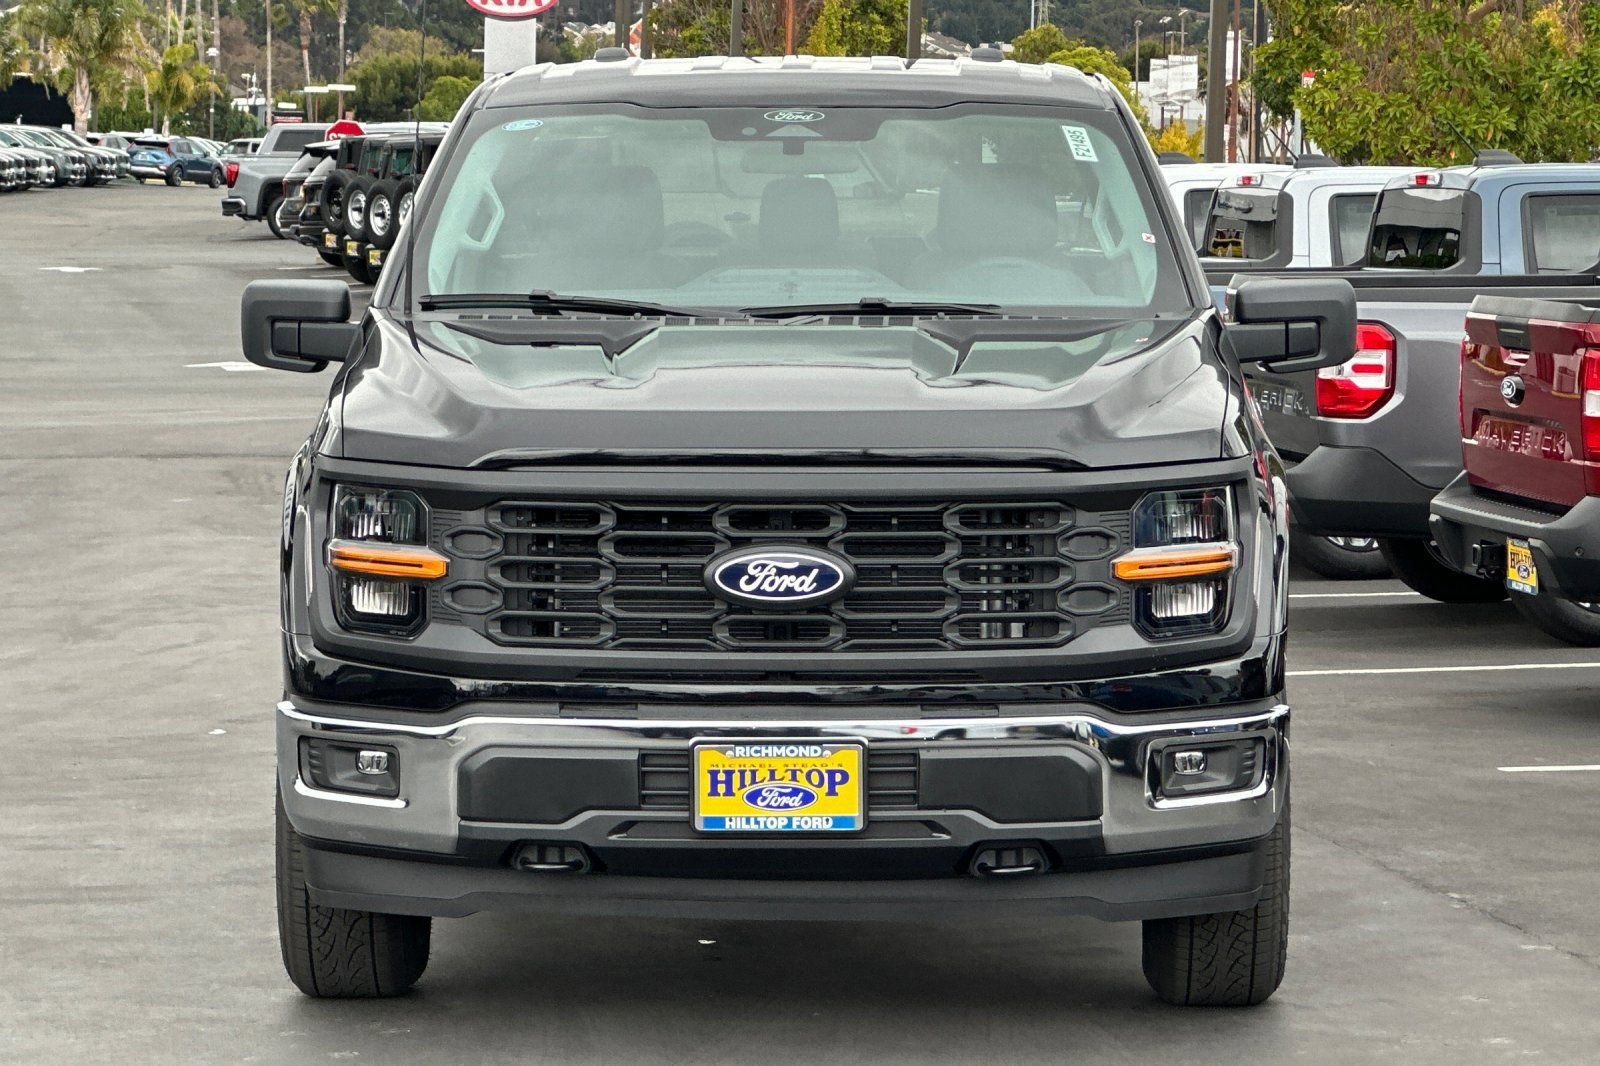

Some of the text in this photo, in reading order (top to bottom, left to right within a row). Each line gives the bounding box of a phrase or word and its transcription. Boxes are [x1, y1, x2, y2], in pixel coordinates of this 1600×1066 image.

[774, 111, 814, 121] Ford
[1067, 130, 1092, 158] F21495
[739, 560, 819, 592] Ford
[735, 746, 822, 758] RICHMOND
[707, 768, 850, 797] HILLTOP
[757, 787, 803, 807] Ford
[725, 817, 833, 829] HILLTOP FORD
